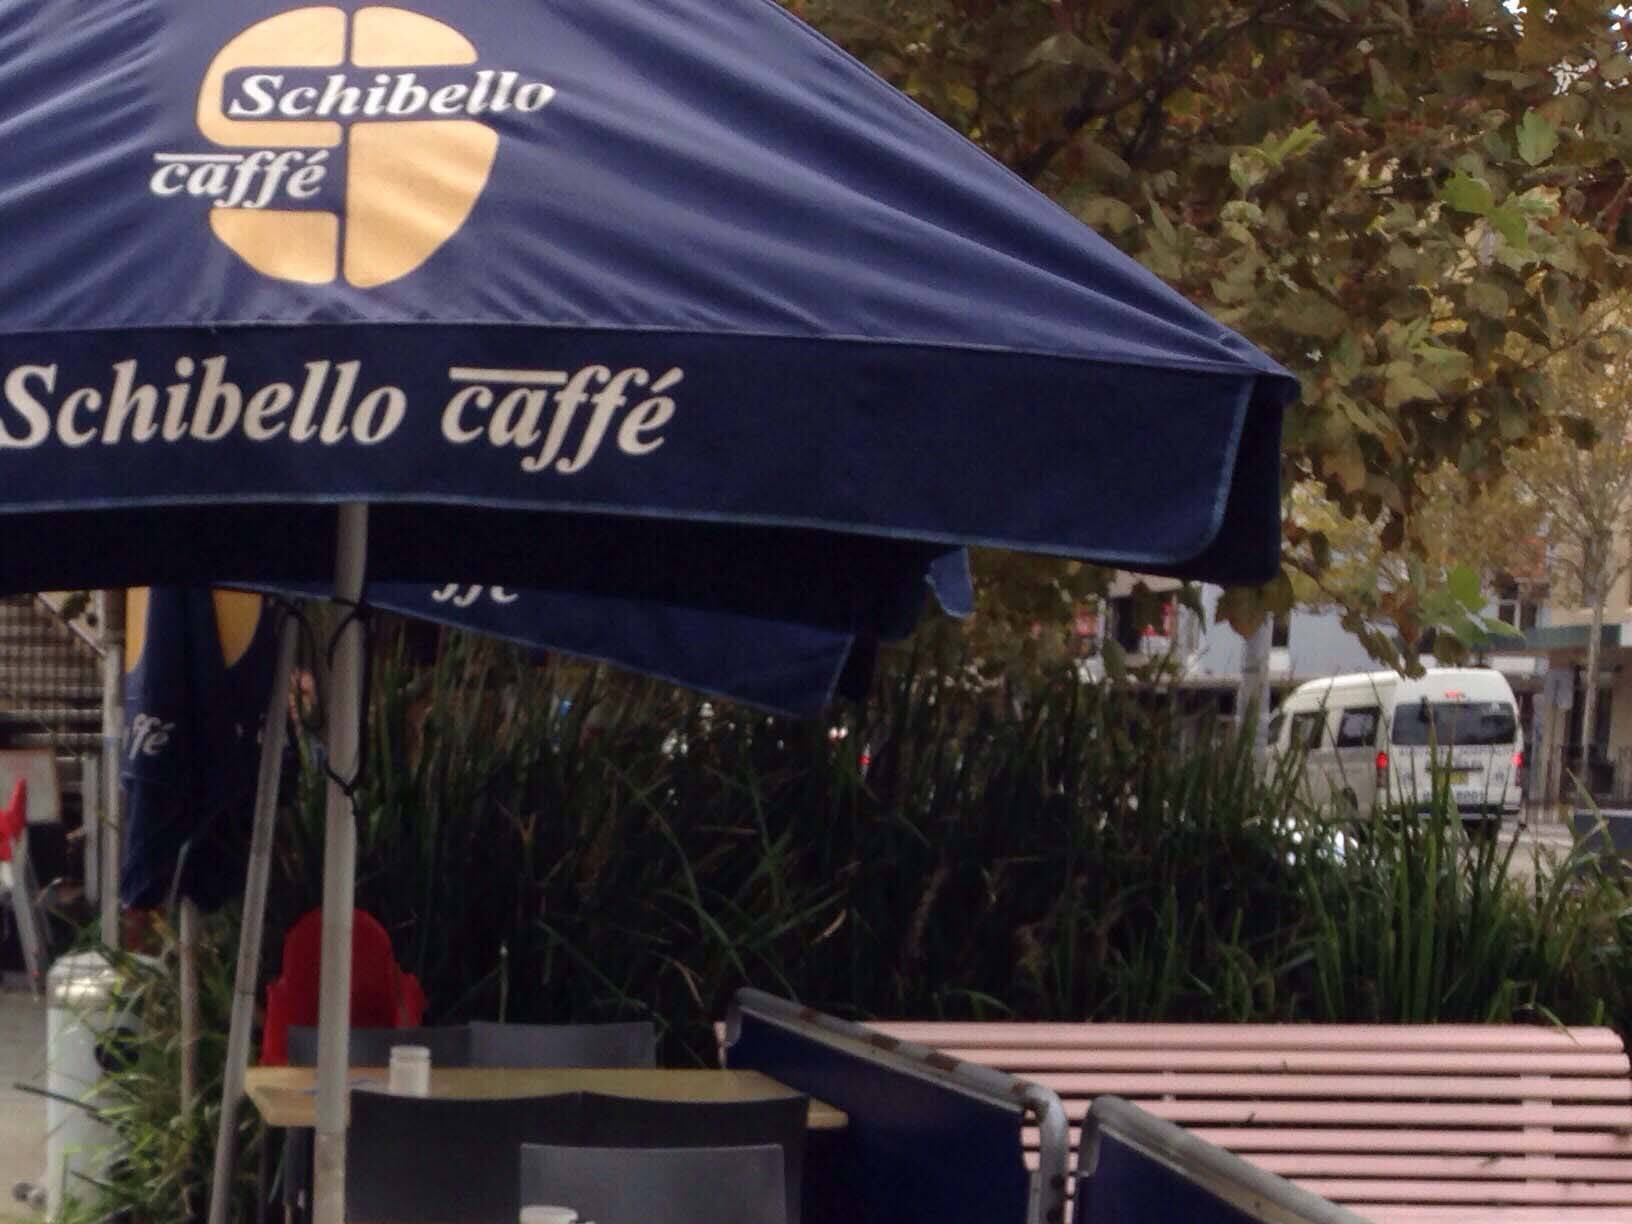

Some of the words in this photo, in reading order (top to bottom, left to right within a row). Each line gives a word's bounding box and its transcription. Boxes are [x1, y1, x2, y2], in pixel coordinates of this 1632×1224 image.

[227, 69, 557, 118] Schibello
[149, 149, 330, 208] caffé
[441, 366, 685, 473] caffé
